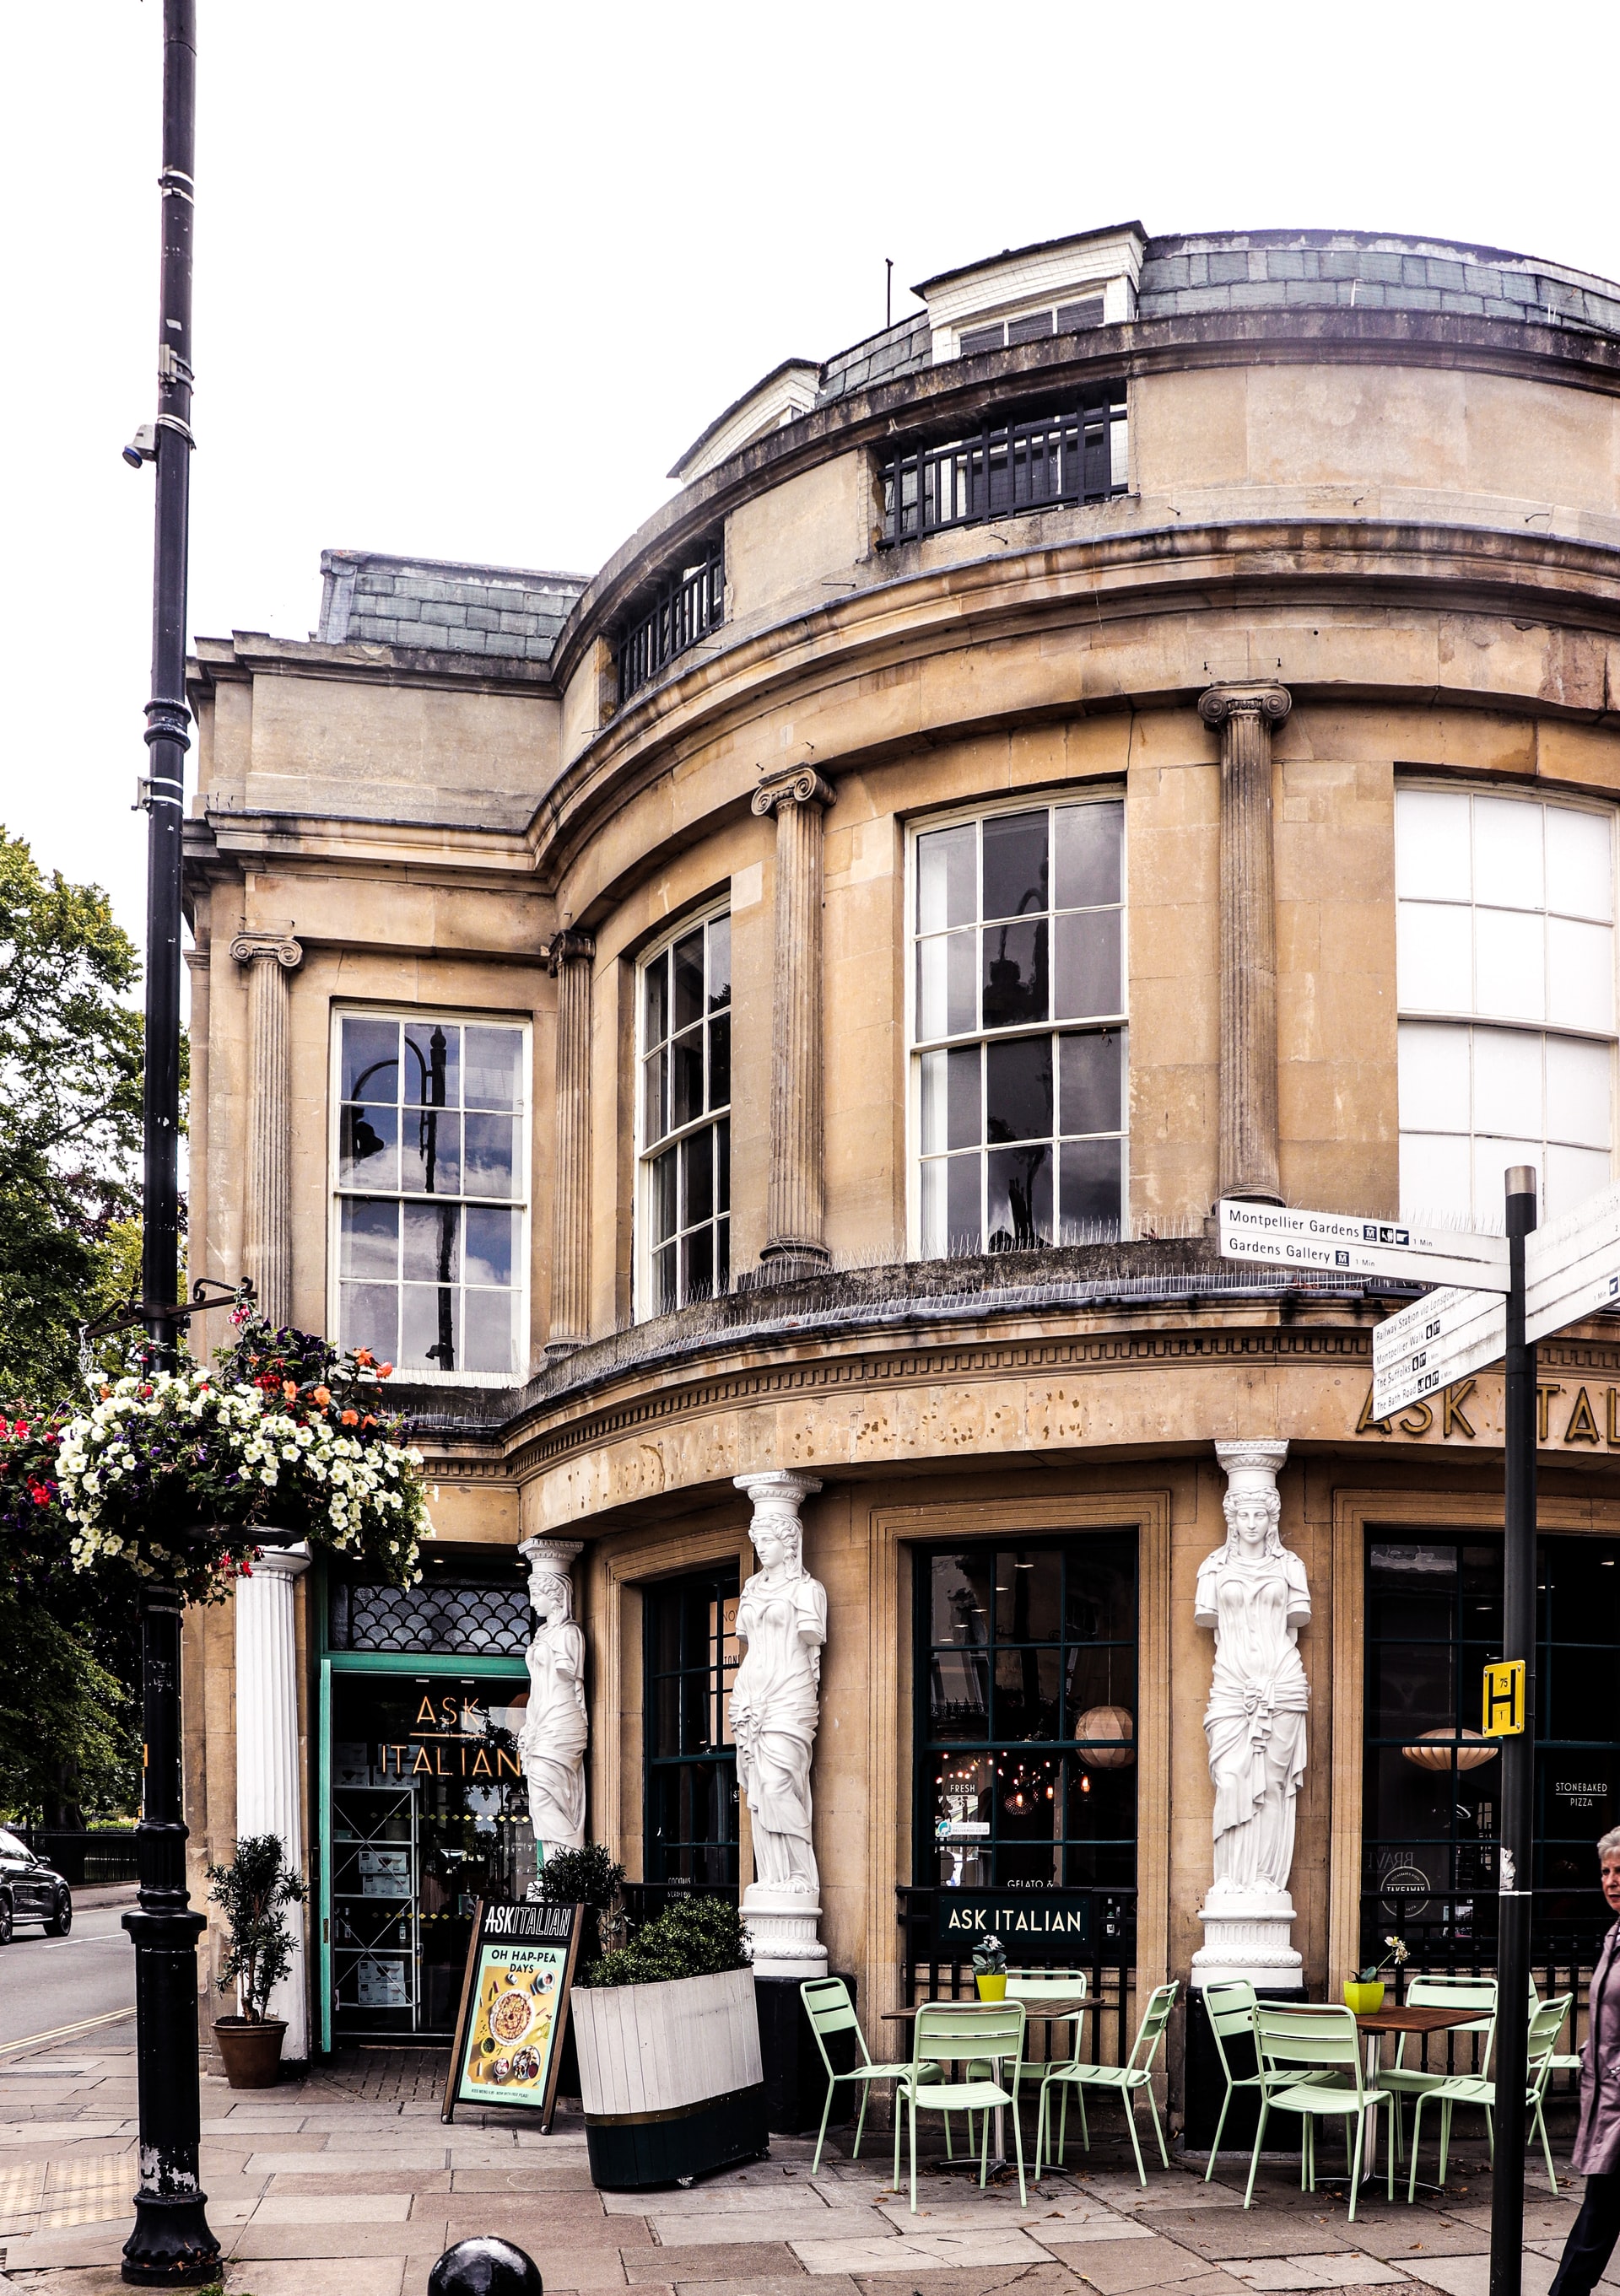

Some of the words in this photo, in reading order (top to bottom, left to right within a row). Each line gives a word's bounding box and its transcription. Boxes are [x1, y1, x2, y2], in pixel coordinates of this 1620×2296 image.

[1229, 1210, 1304, 1230] Montpellier
[1310, 1220, 1359, 1237] Gardens
[1229, 1238, 1281, 1256] Gardens
[1286, 1245, 1331, 1264] Gallery
[1376, 1323, 1397, 1342] Railway
[1398, 1310, 1420, 1329] Station
[1376, 1341, 1408, 1365] Montpellier
[1409, 1331, 1424, 1346] Walk
[1376, 1378, 1386, 1389] The
[1387, 1363, 1412, 1383] Suffolks
[1376, 1401, 1387, 1413] The
[1388, 1393, 1401, 1407] Bath
[1402, 1386, 1417, 1399] Road
[1499, 1678, 1509, 1688] 75
[416, 1695, 480, 1726] ASK
[1488, 1669, 1516, 1729] H
[382, 1744, 521, 1777] ITALIAN
[950, 1784, 975, 1793] FRESH
[1555, 1782, 1607, 1792] STONEBAKED
[1570, 1797, 1593, 1807] PIZZA
[1007, 1879, 1044, 1888] GELATO
[948, 1908, 987, 1930] ASK
[995, 1909, 1082, 1932] ITALIAN
[491, 1949, 508, 1960] OH
[511, 1950, 557, 1963] HAP-PEA
[510, 1963, 534, 1974] DAYS
